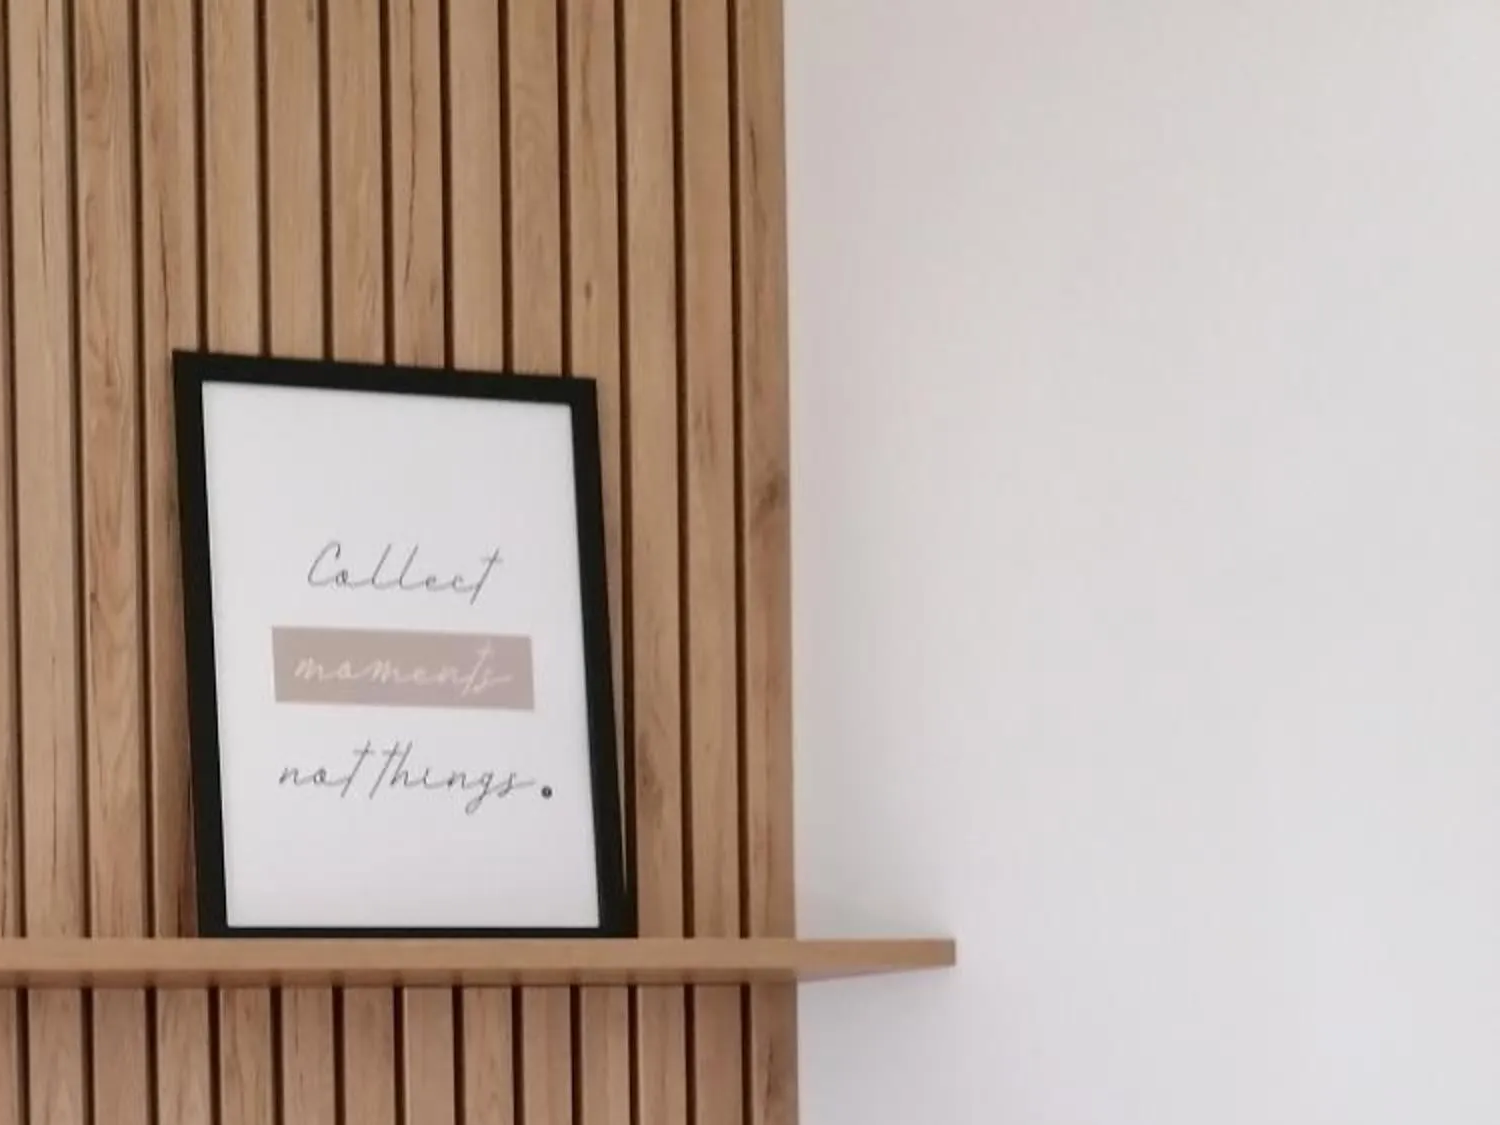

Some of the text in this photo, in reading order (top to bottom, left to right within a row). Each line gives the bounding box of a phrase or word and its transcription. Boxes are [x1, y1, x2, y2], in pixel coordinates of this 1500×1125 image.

[306, 540, 504, 605] Collect
[294, 639, 513, 698] moments
[278, 741, 553, 815] not things.
